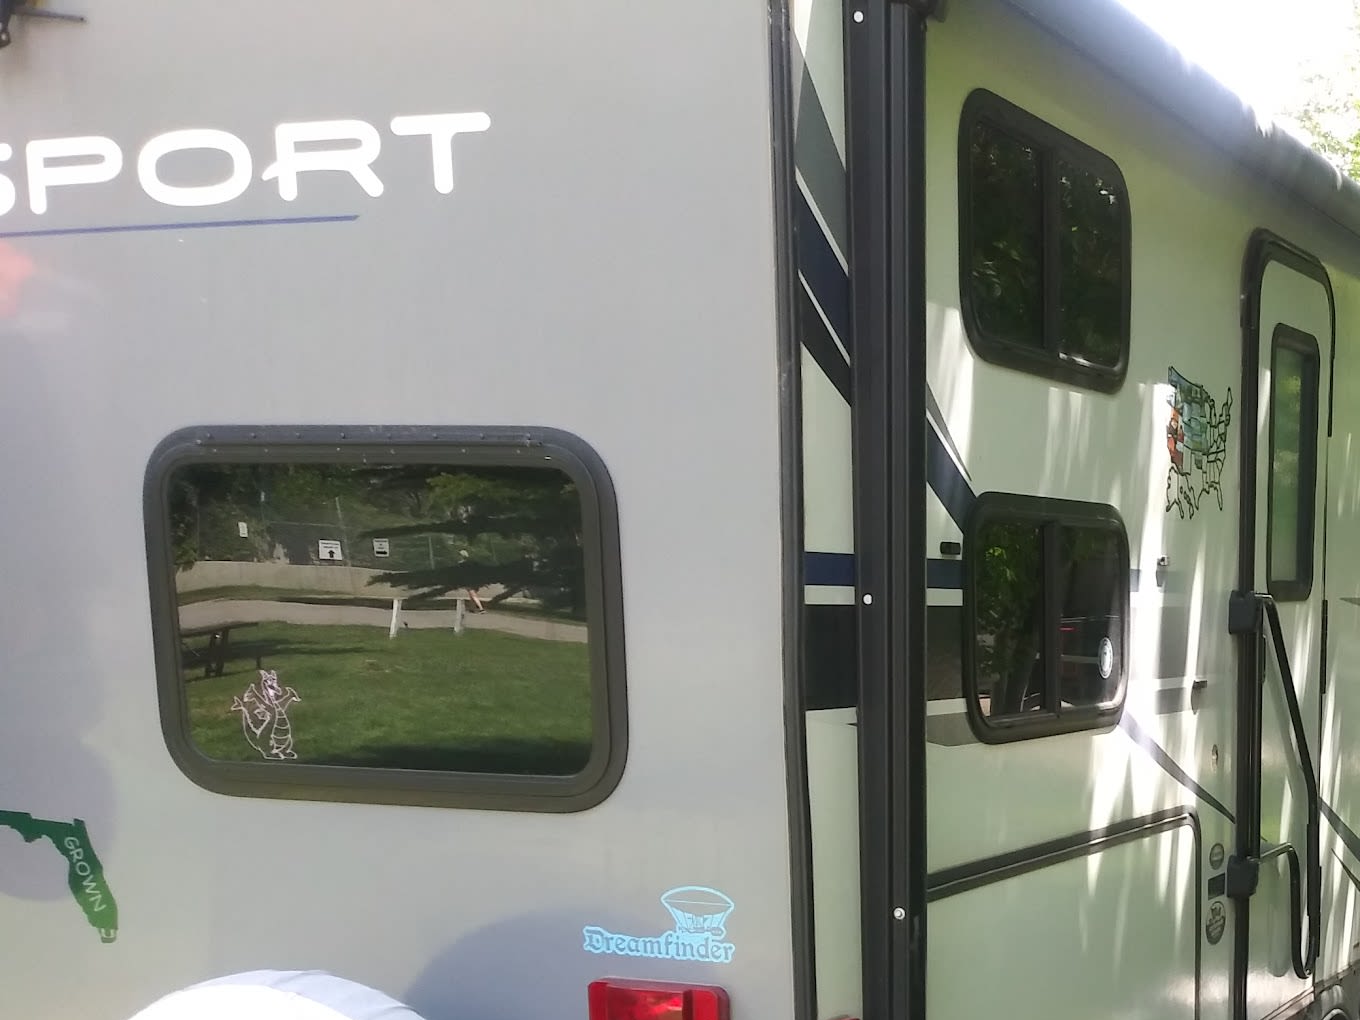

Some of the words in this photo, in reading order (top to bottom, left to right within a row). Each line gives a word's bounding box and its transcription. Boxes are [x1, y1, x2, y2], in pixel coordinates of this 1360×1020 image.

[0, 111, 491, 216] PORT
[63, 836, 108, 912] GROWN
[584, 928, 733, 961] Dreamfinder
